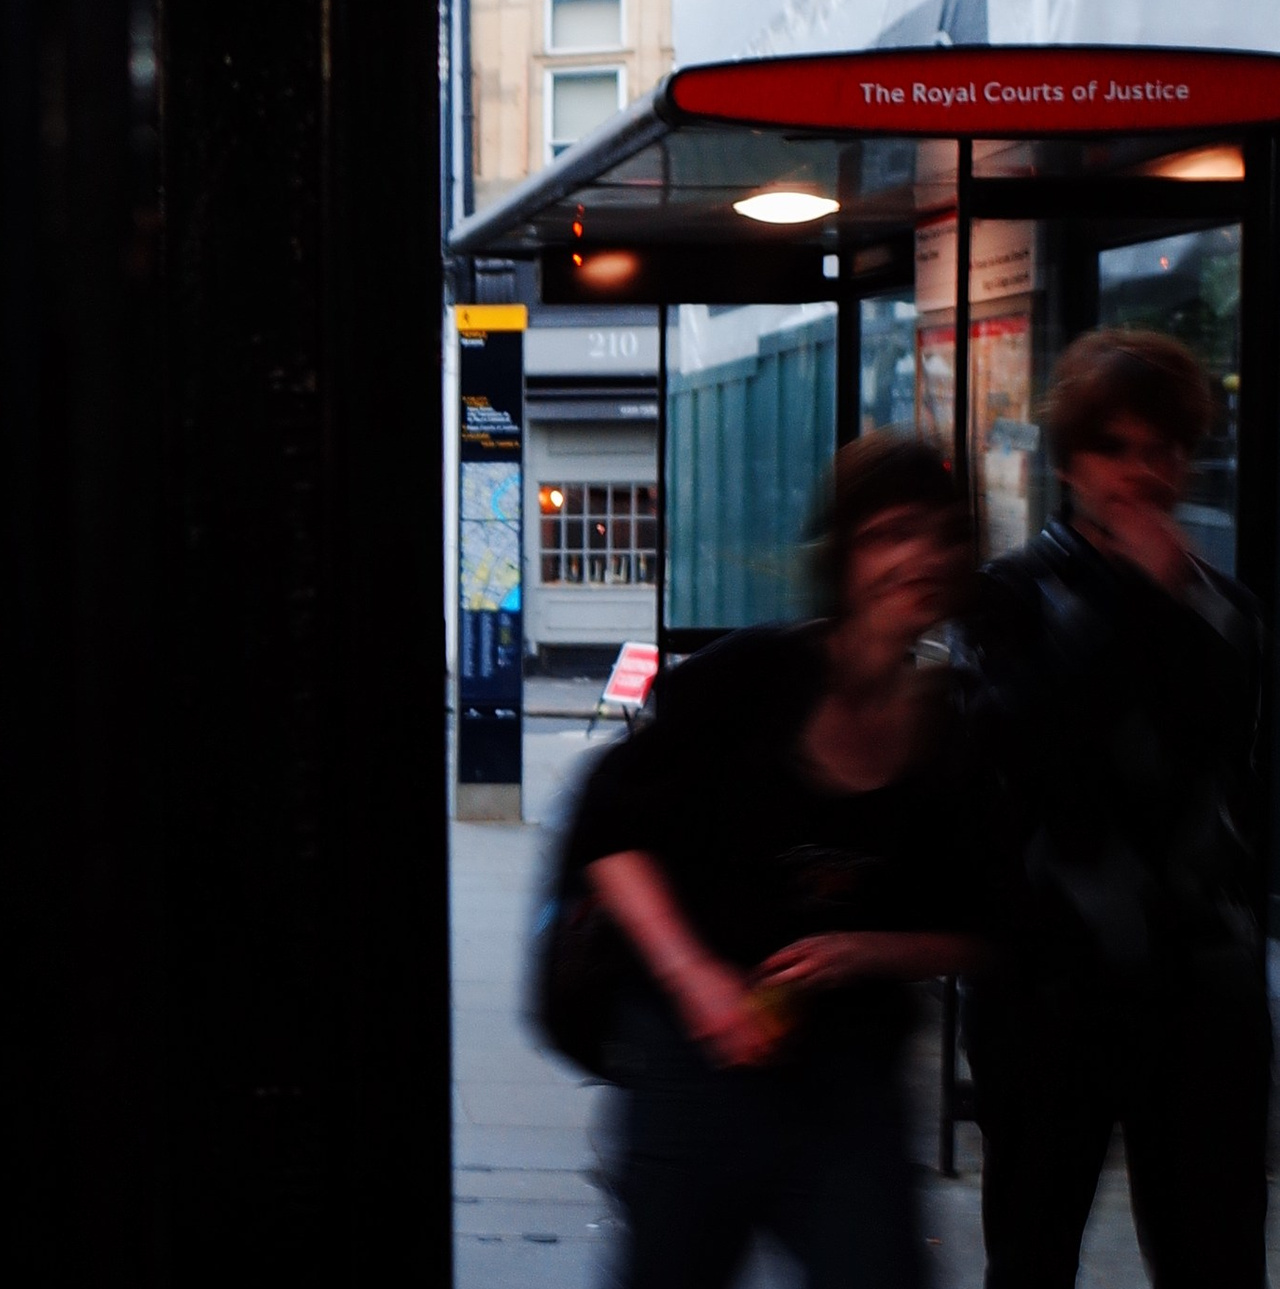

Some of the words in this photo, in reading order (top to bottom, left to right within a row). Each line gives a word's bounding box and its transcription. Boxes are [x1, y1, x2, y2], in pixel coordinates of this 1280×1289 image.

[860, 82, 905, 103] The
[912, 82, 976, 107] Royal
[983, 81, 1063, 102] Courts
[1071, 81, 1098, 101] of
[1104, 80, 1189, 100] Justice
[588, 332, 638, 357] 210
